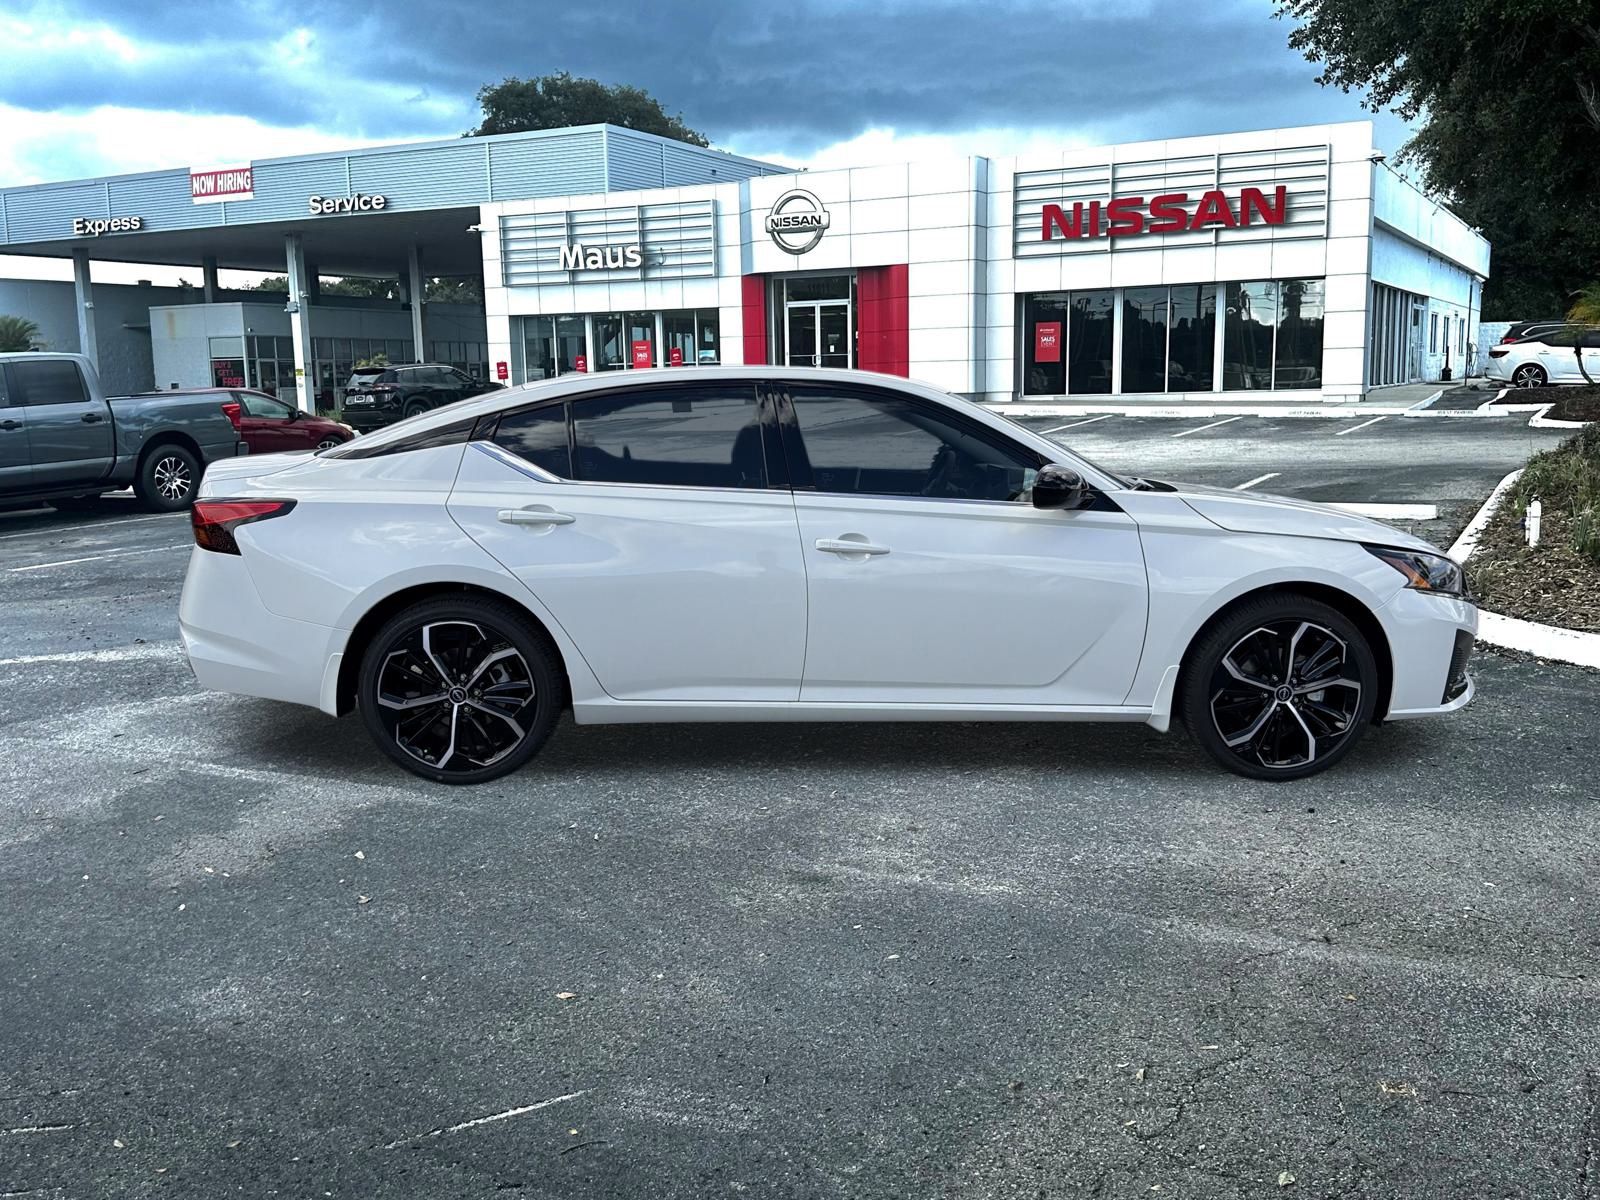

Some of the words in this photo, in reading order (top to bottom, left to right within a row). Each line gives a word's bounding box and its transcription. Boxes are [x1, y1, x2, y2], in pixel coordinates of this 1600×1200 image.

[192, 175, 214, 195] NOW
[217, 171, 251, 192] HIRING
[308, 193, 386, 215] Service
[1042, 185, 1287, 241] NISSAN
[72, 215, 141, 237] Express
[770, 215, 823, 229] NISSAN
[558, 243, 642, 270] Maus
[217, 369, 229, 377] GET
[223, 377, 244, 387] FREE
